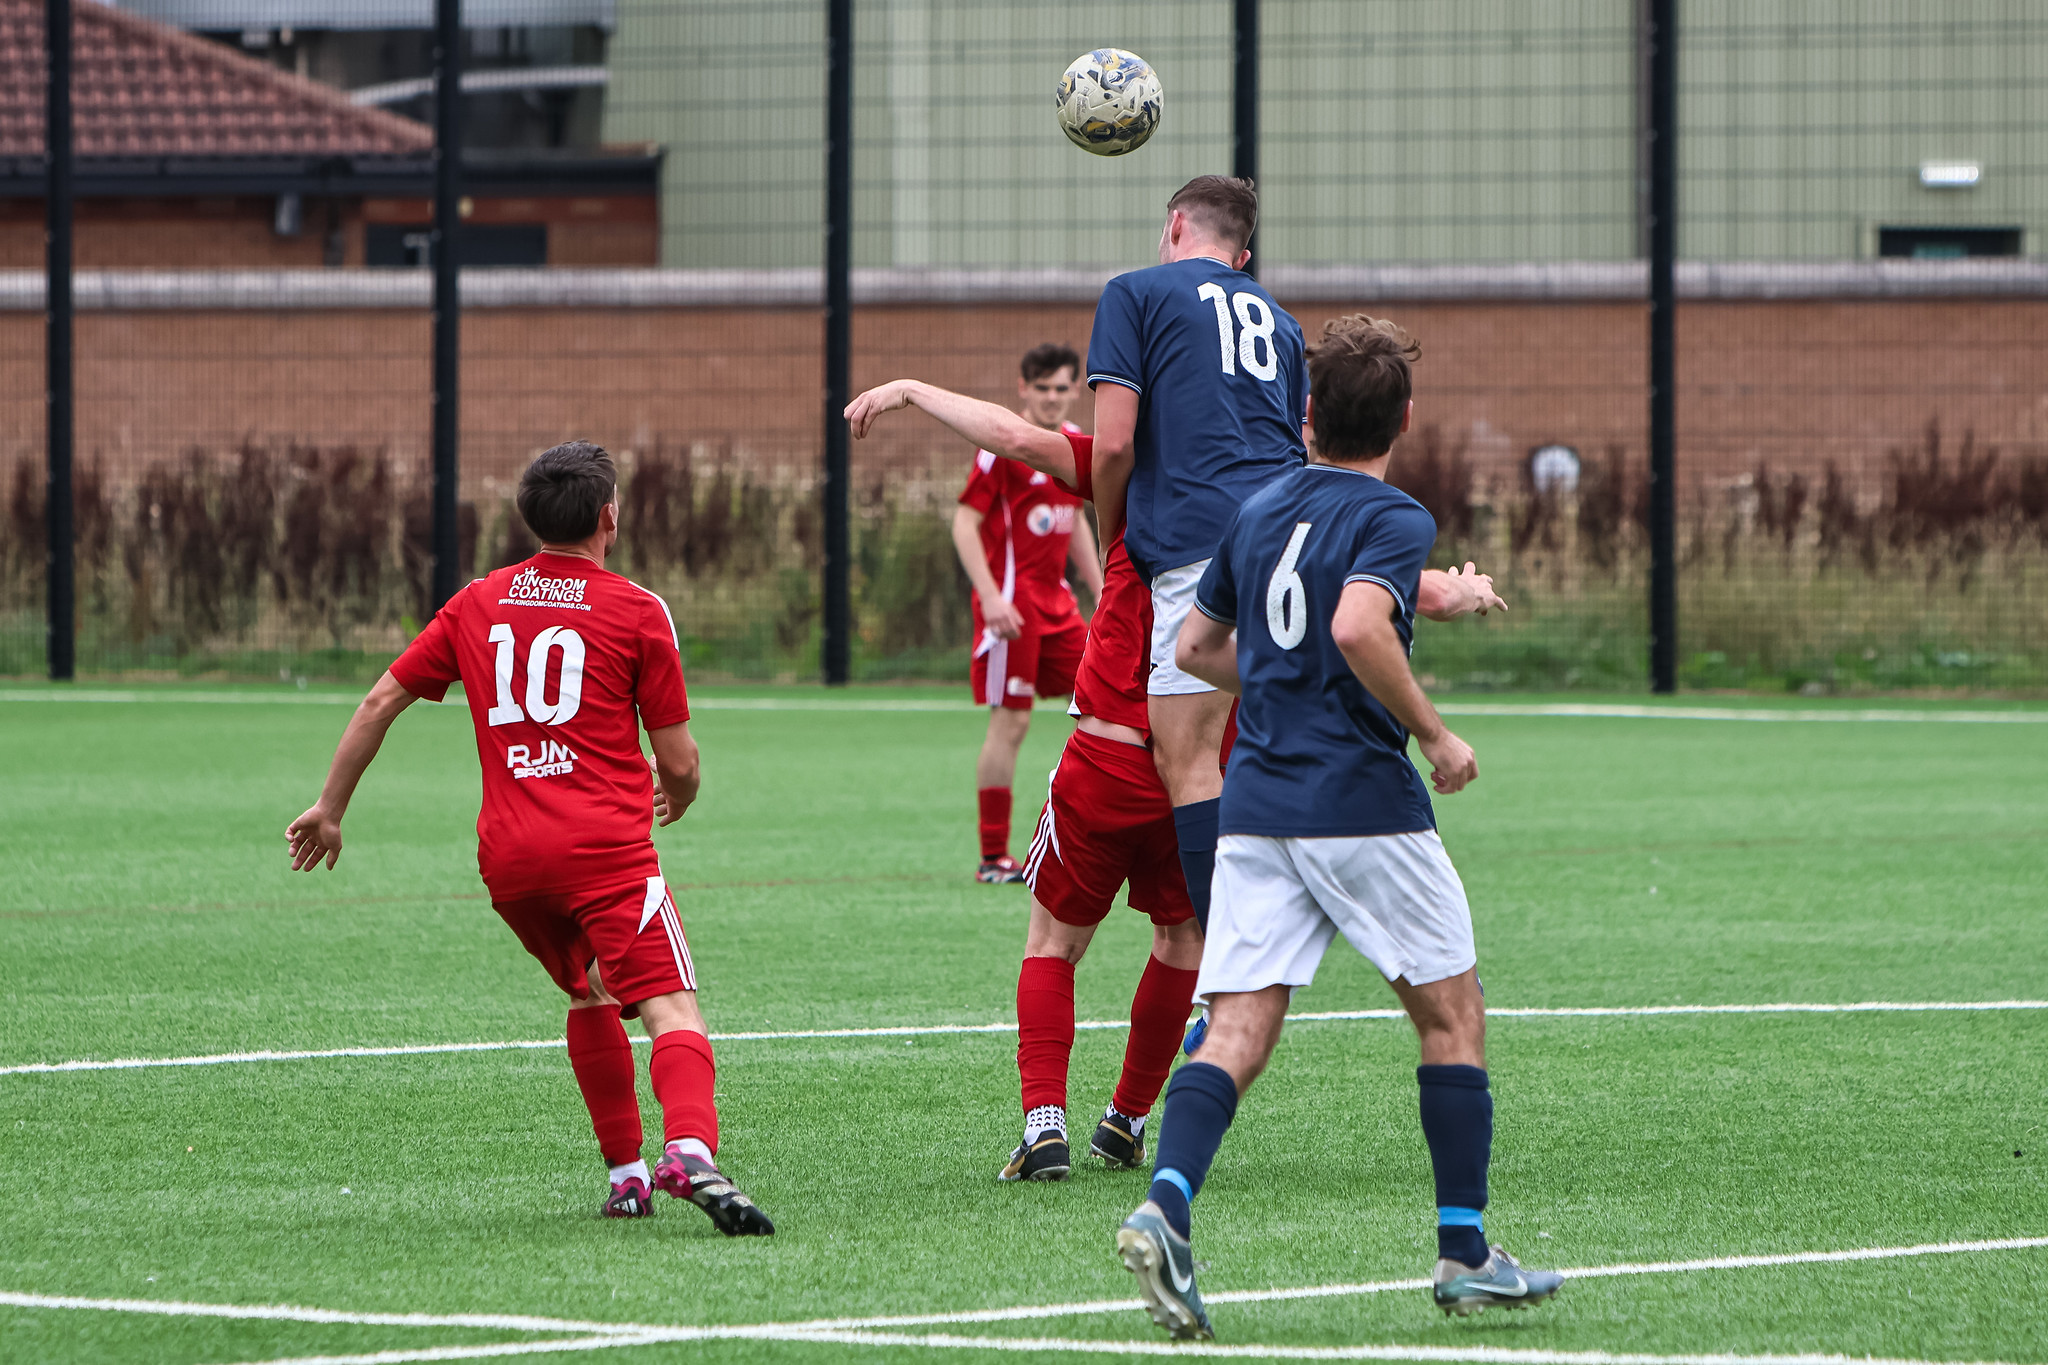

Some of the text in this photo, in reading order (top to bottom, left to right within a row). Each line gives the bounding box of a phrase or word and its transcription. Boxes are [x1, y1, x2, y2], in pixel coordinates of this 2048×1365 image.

[1197, 282, 1277, 381] 18
[508, 585, 584, 602] COATINGS
[512, 573, 587, 591] KINGDOM
[1266, 522, 1312, 650] 6
[498, 599, 592, 611] WWW.KINGDOMCOATINGS.COM
[488, 623, 586, 727] 10
[507, 739, 579, 768] RJM
[513, 761, 574, 779] SPORTS
